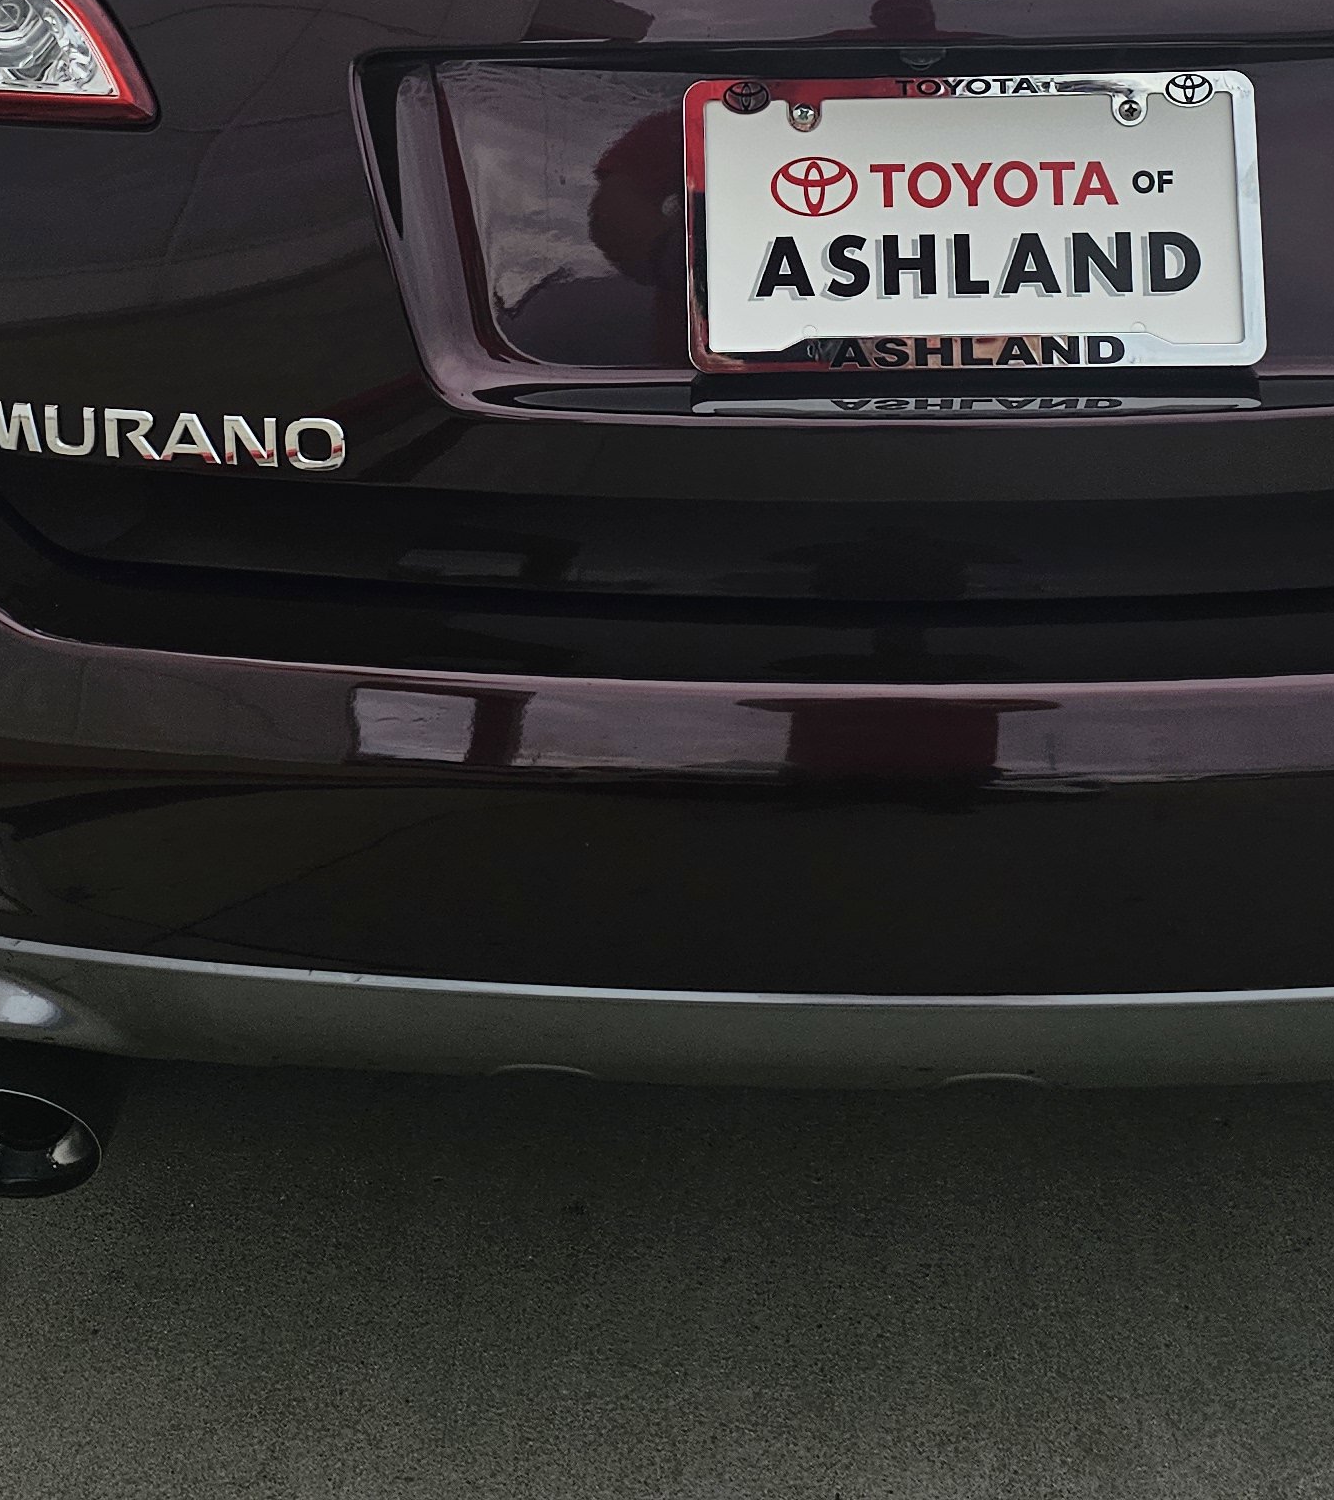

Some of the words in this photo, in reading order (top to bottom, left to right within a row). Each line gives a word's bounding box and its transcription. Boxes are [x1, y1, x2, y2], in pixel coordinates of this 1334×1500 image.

[895, 77, 1039, 96] TOYOTA
[869, 159, 1120, 209] TOYOTA
[1131, 169, 1174, 194] OF
[751, 231, 1202, 299] ASHLAND
[829, 335, 1126, 369] ASHLAND
